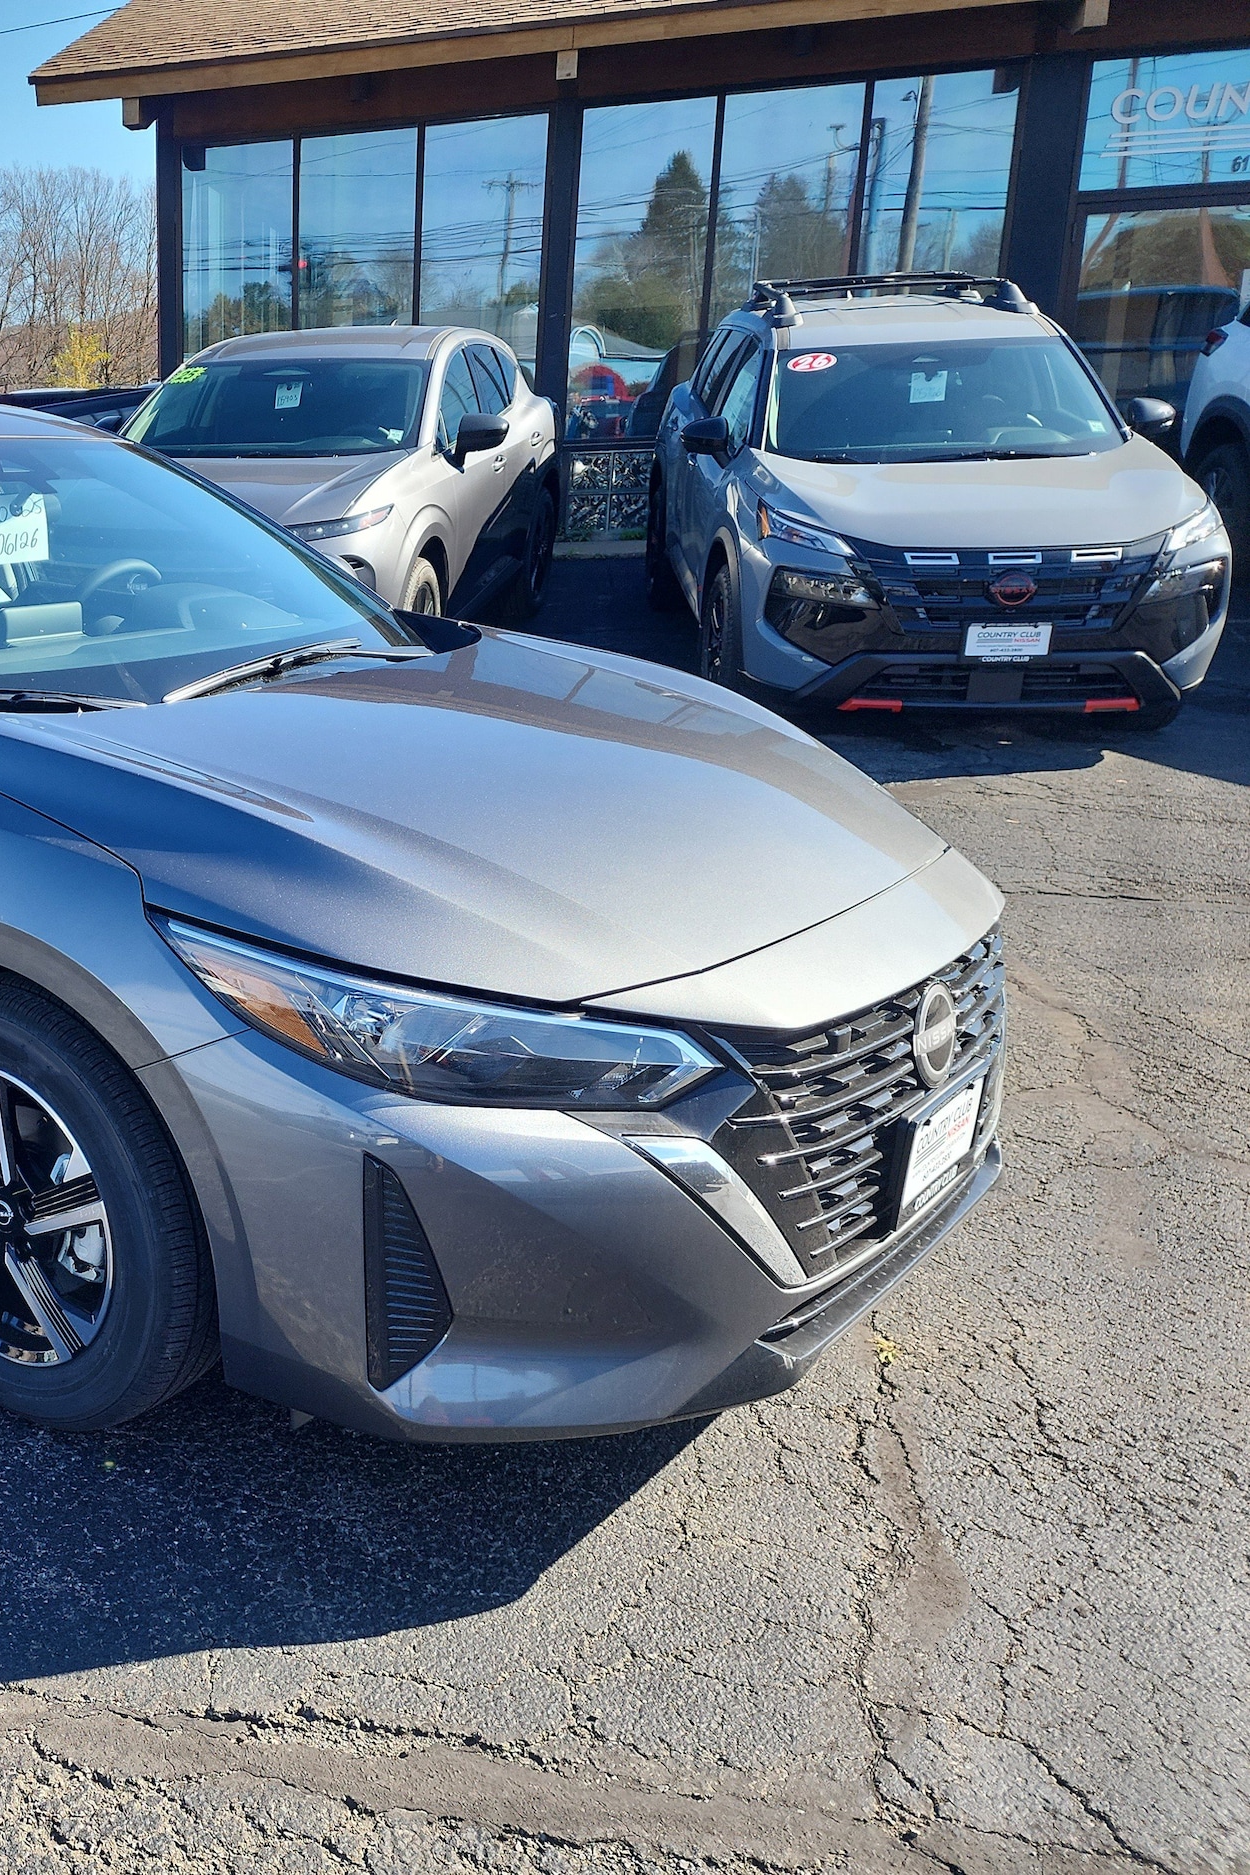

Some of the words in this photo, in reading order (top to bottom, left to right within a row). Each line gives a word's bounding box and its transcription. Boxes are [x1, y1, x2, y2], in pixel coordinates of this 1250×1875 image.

[796, 353, 831, 369] 26
[916, 1111, 954, 1154] COUNTRY
[953, 1097, 973, 1123] CLUB
[947, 1114, 971, 1137] NISSAN
[914, 1179, 942, 1210] COUNTRY
[940, 1164, 959, 1191] CLUB
